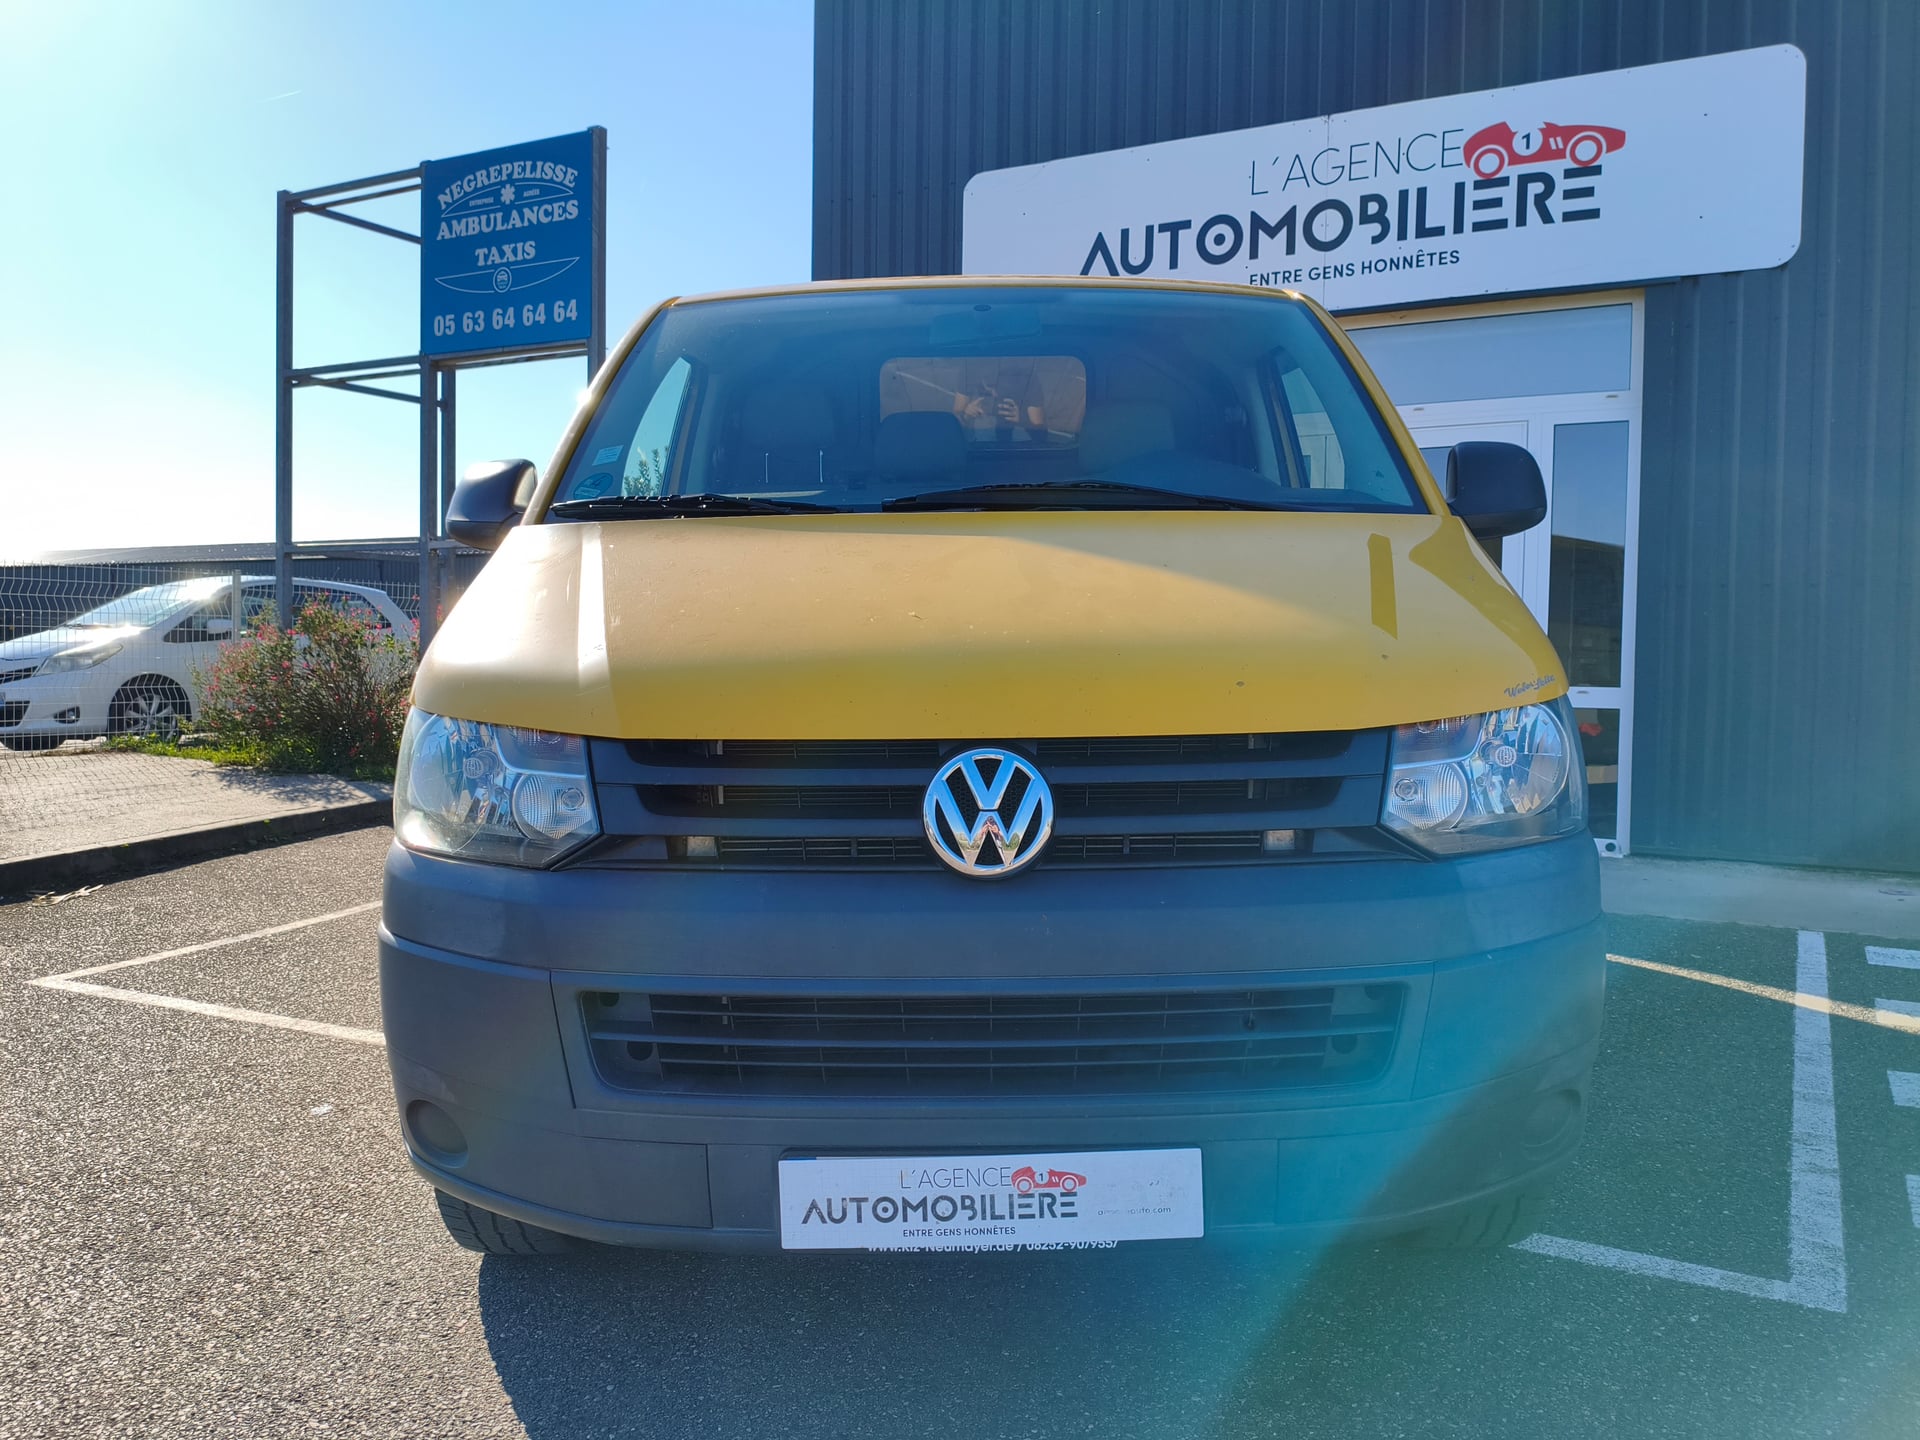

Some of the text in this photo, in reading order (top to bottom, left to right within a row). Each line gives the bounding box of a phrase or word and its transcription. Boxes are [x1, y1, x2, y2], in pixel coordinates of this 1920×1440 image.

[437, 161, 578, 209] NEGREPELISSE
[436, 200, 578, 241] AMBULANCES
[1079, 164, 1602, 276] AUTOMOBILIERE
[475, 241, 536, 266] TAXIS
[1249, 248, 1460, 286] ENTRE GENS HONNÊTES
[434, 299, 578, 336] 05 63 64 64 64
[801, 1191, 1079, 1225] AUTOMOBILIERE
[903, 1225, 1016, 1238] ENTRE GENS HONNÊTES
